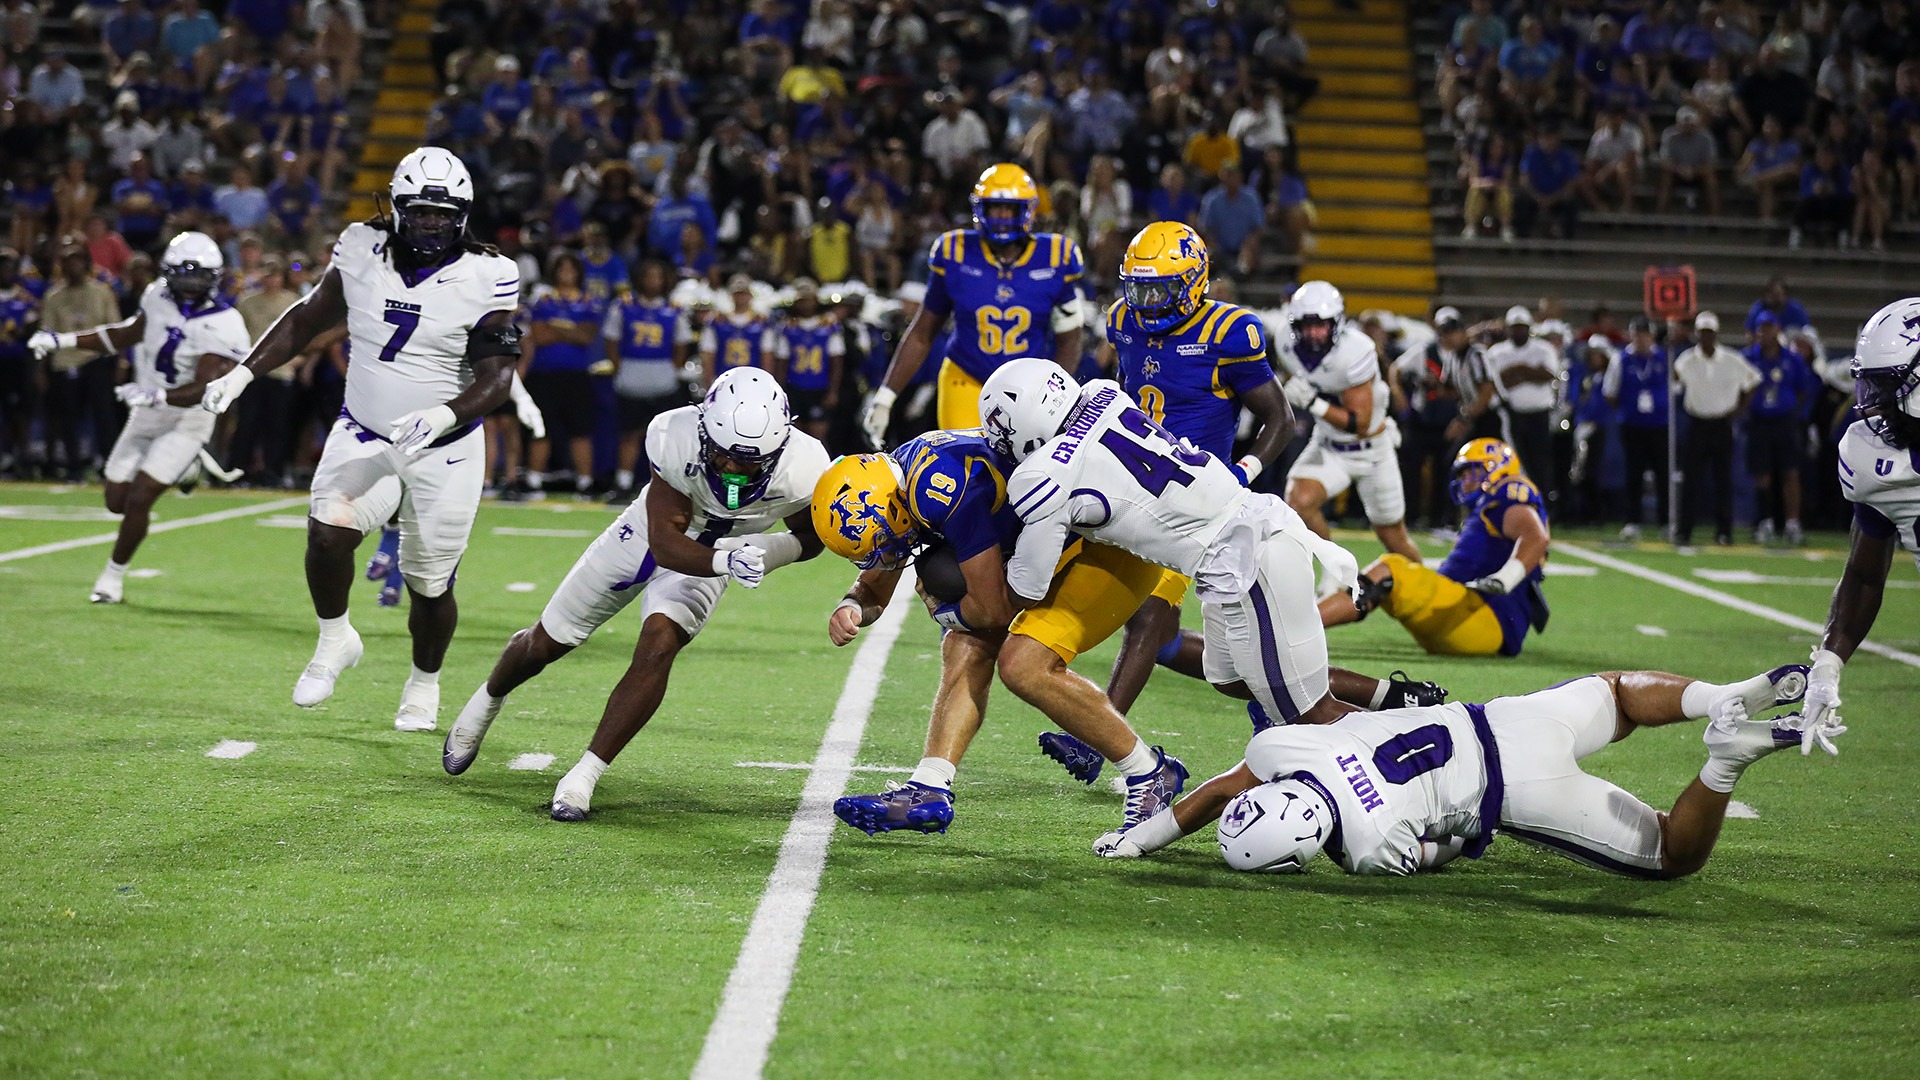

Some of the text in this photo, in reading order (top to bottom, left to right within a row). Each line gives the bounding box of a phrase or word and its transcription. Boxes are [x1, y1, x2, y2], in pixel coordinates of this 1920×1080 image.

[379, 309, 421, 362] 7
[975, 305, 1032, 355] 62
[1246, 324, 1261, 349] 0
[1047, 372, 1065, 393] 43
[1138, 384, 1166, 426] 0
[1098, 407, 1211, 498] 43
[925, 472, 957, 506] 19
[1372, 723, 1454, 785] 0
[1335, 753, 1385, 814] HOLT
